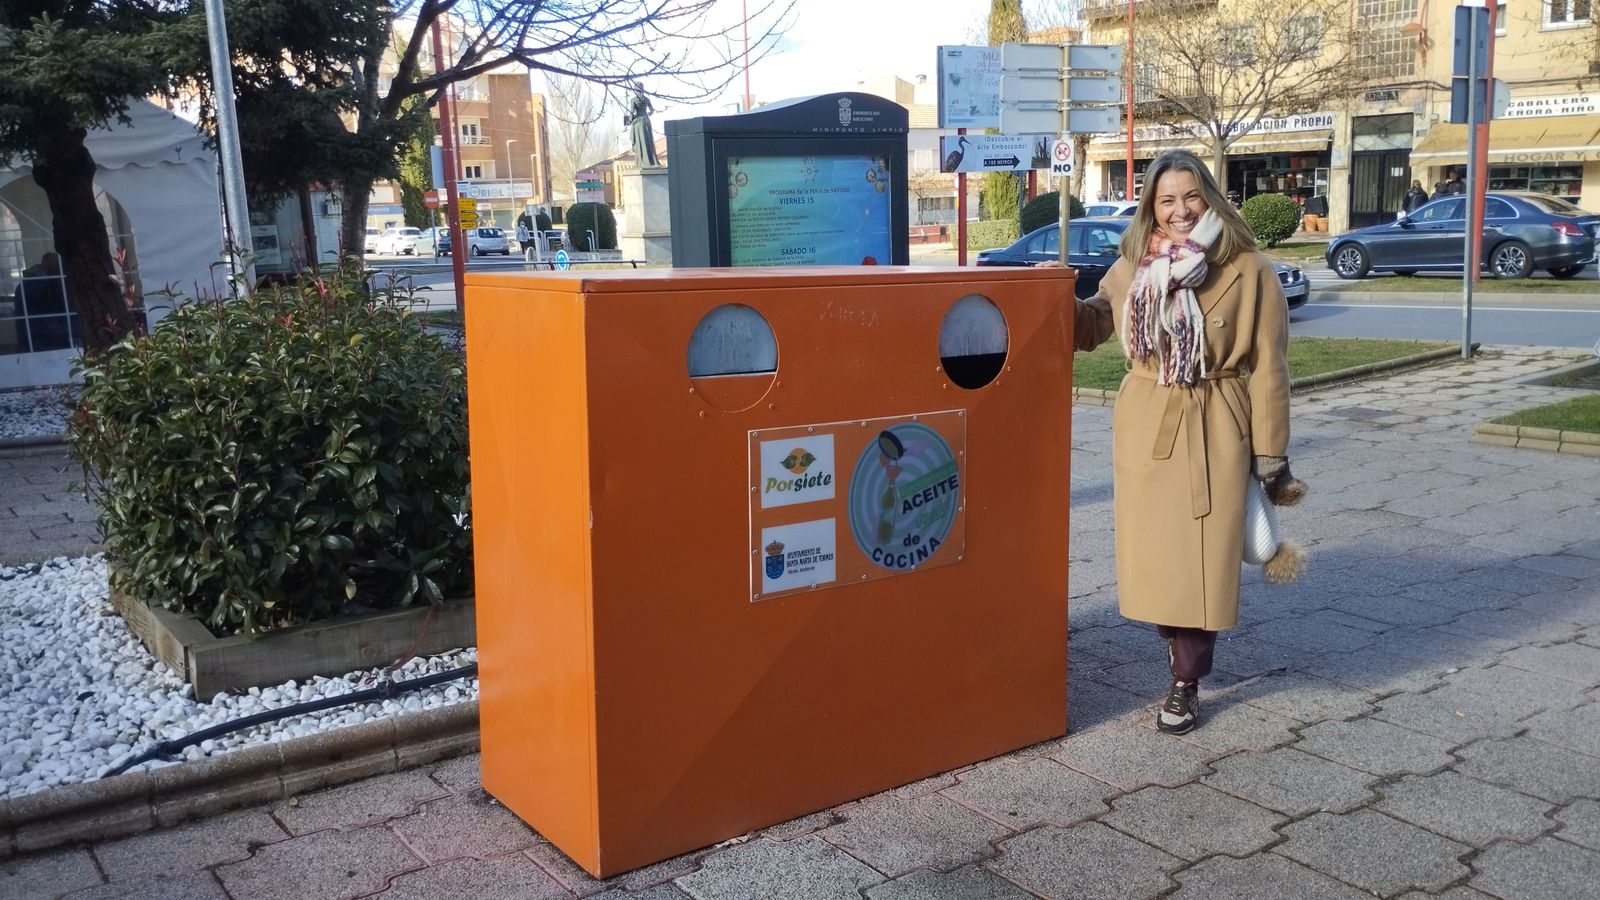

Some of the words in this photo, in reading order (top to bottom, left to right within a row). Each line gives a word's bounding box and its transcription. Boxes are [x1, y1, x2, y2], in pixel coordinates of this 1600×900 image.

[1508, 96, 1590, 108] CABALLERO
[1294, 115, 1334, 129] PROPIA
[1504, 151, 1564, 164] HOGAR
[1053, 163, 1072, 173] NO
[765, 471, 832, 494] Porsiete
[902, 474, 959, 515] ACEITE
[903, 532, 921, 548] de
[871, 536, 942, 569] COCINA
[786, 559, 799, 568] SANTA
